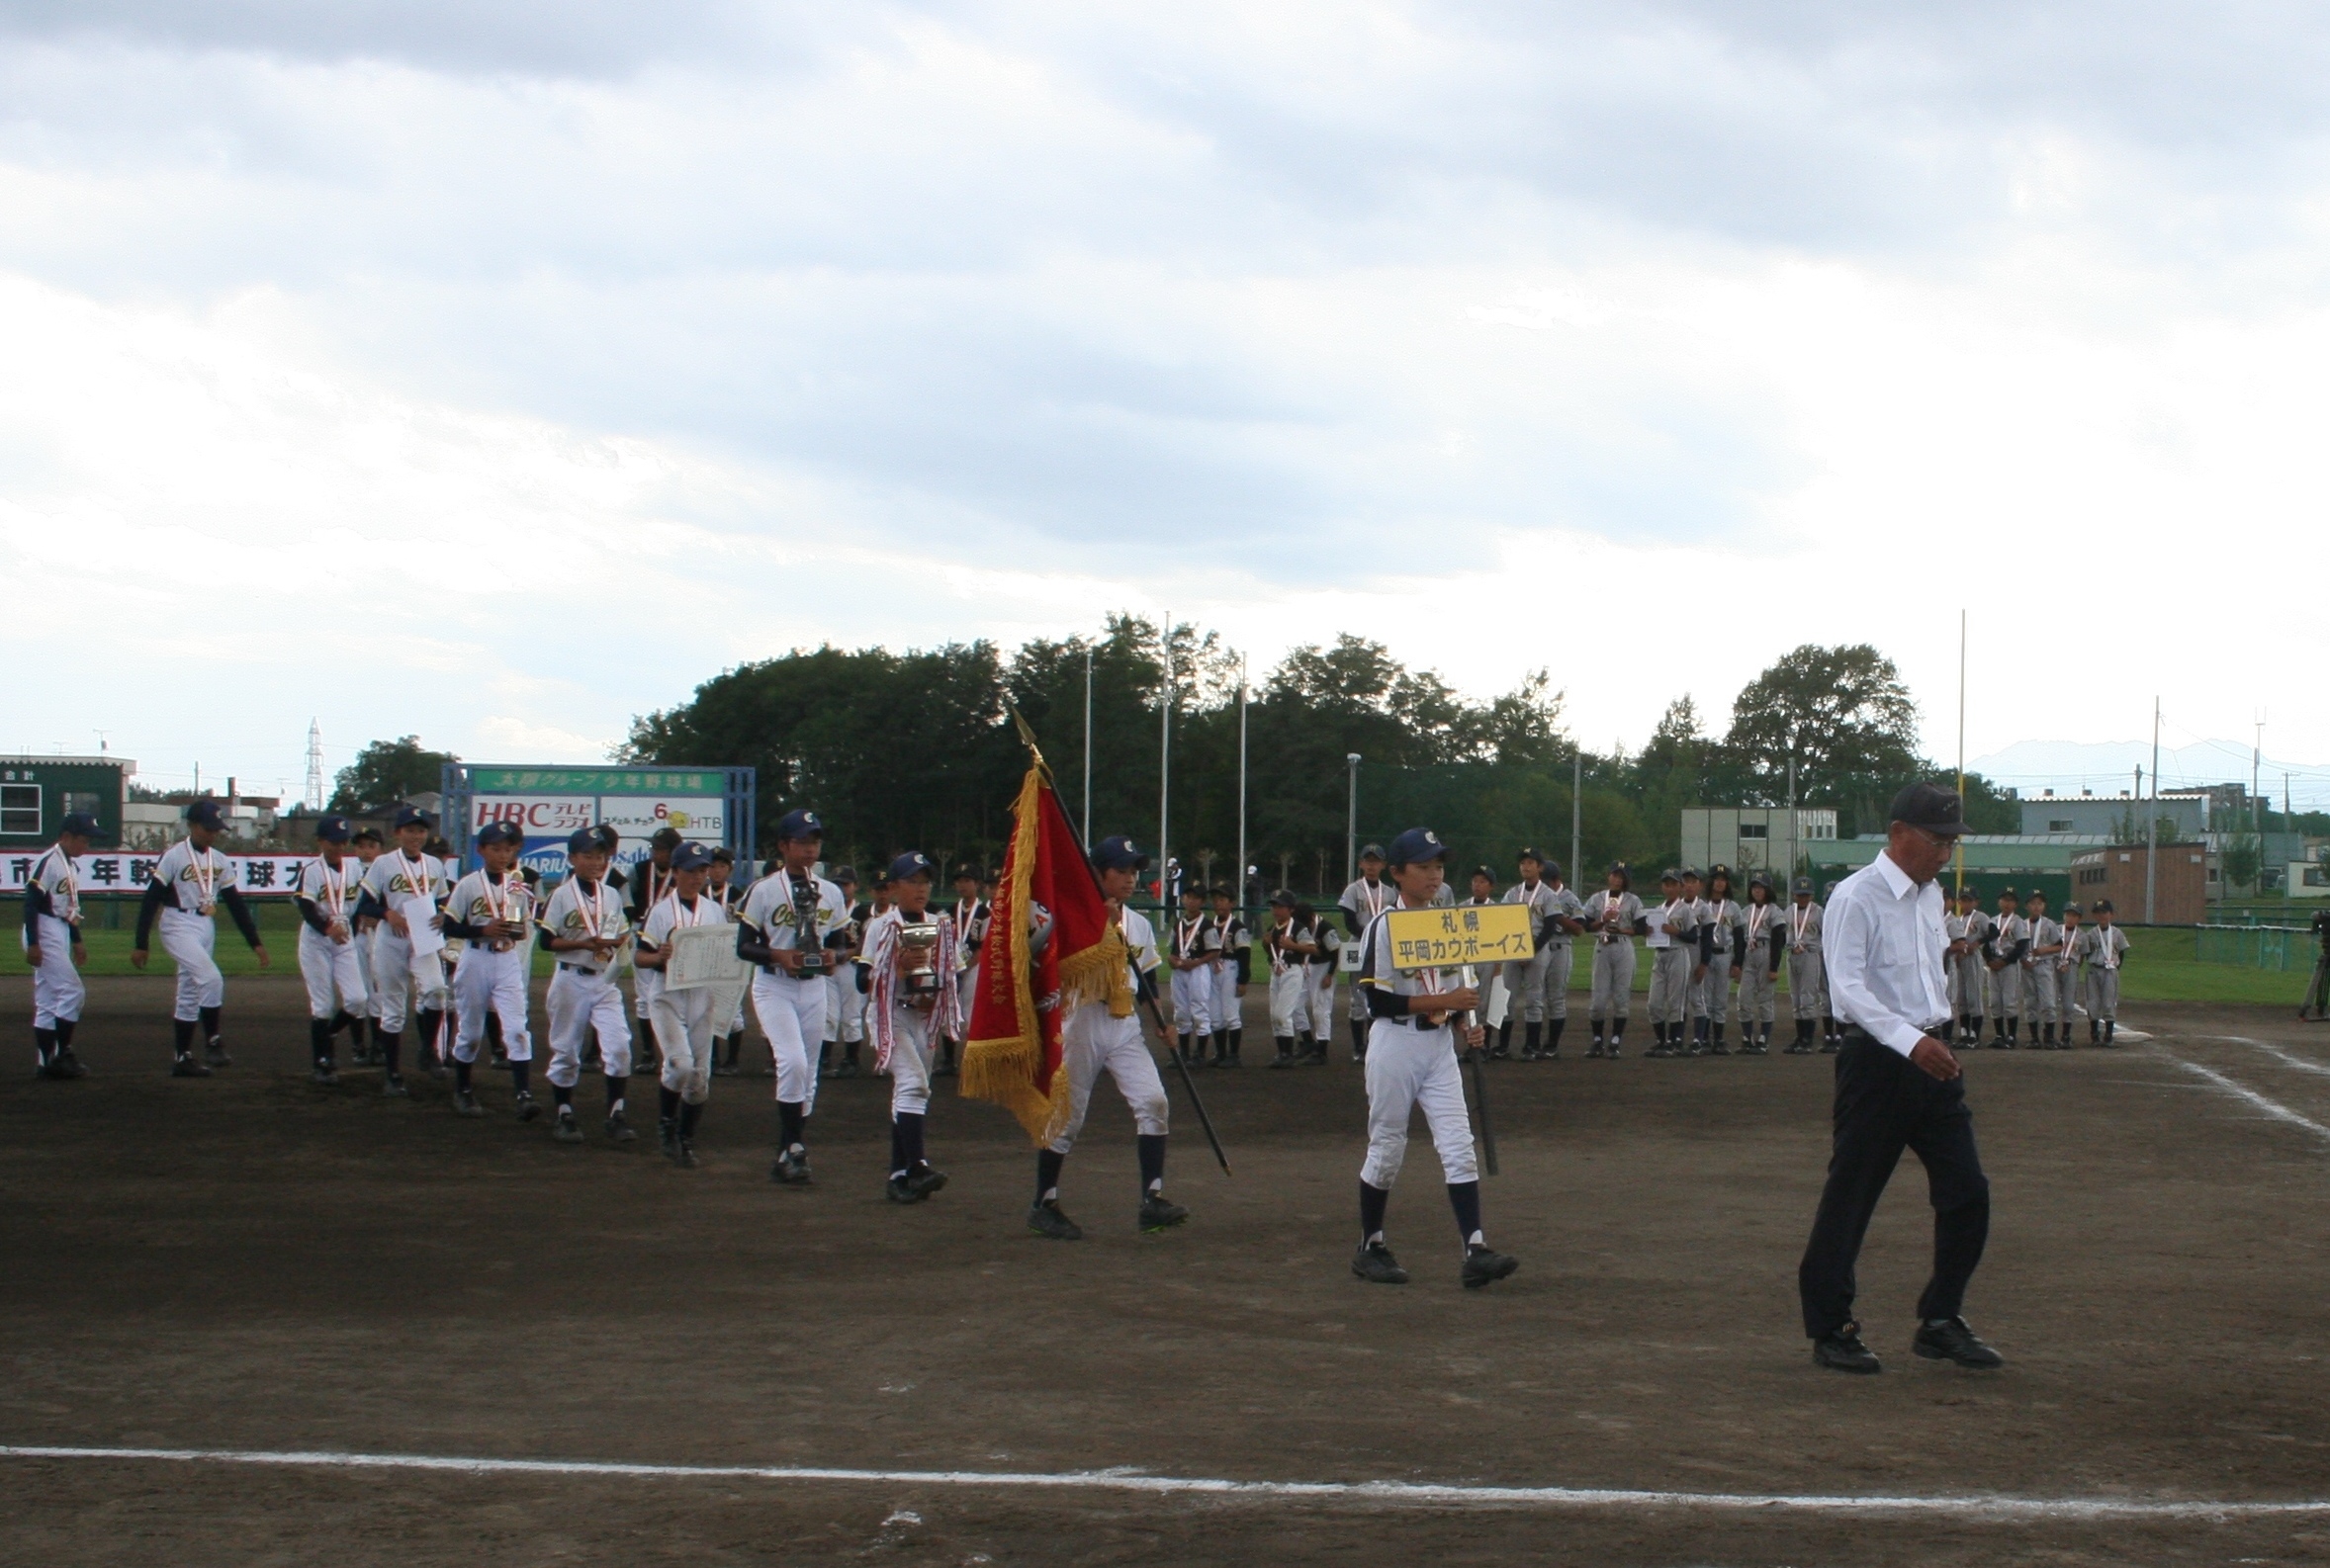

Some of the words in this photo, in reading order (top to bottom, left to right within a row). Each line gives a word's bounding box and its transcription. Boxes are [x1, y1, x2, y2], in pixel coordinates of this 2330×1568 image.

[477, 802, 551, 828] HBC
[554, 803, 592, 816] テレビ
[654, 803, 669, 820] 6
[690, 817, 723, 828] HTB
[1441, 911, 1480, 934] 札幌
[1397, 931, 1528, 963] 平岡カウボーイズ
